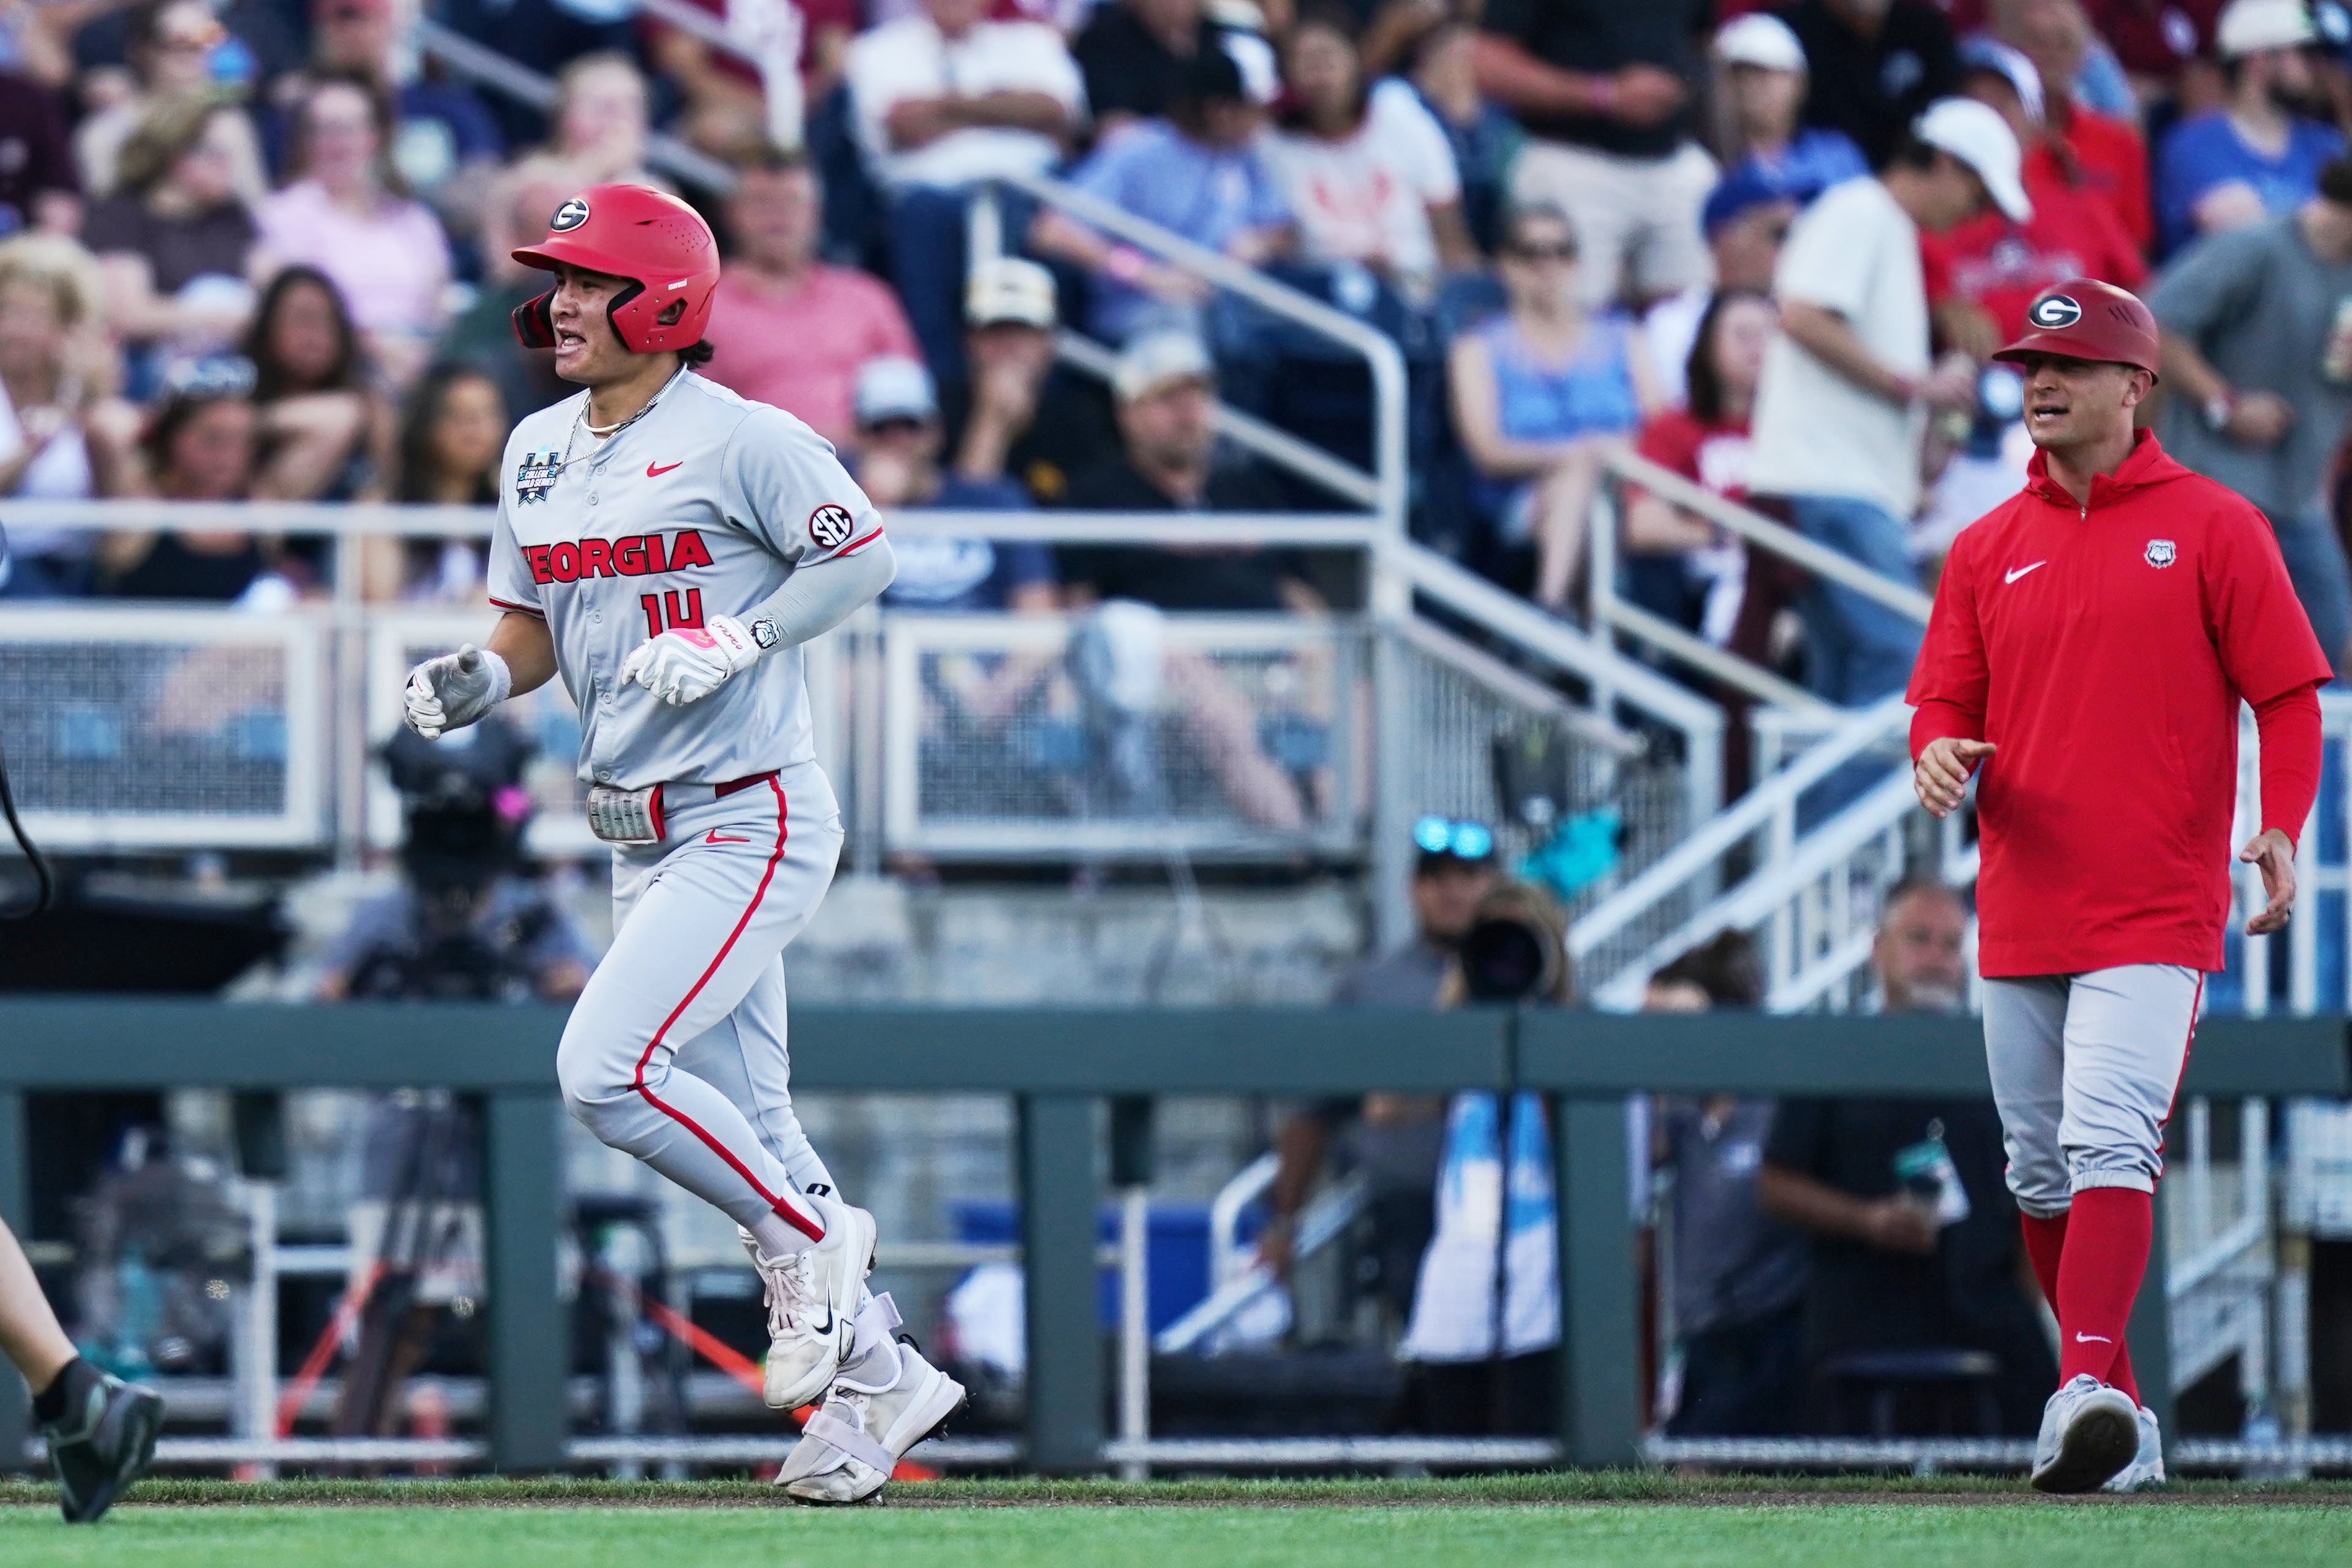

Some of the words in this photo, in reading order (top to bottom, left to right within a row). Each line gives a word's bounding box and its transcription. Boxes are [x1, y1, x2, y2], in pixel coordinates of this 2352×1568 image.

[552, 199, 588, 230] G
[2031, 296, 2081, 327] G
[517, 480, 535, 490] WORLD
[534, 478, 556, 488] SERIES
[525, 470, 549, 480] COLLEGE
[812, 507, 850, 546] SEC
[522, 529, 714, 585] EORGIA
[641, 588, 704, 639] 14
